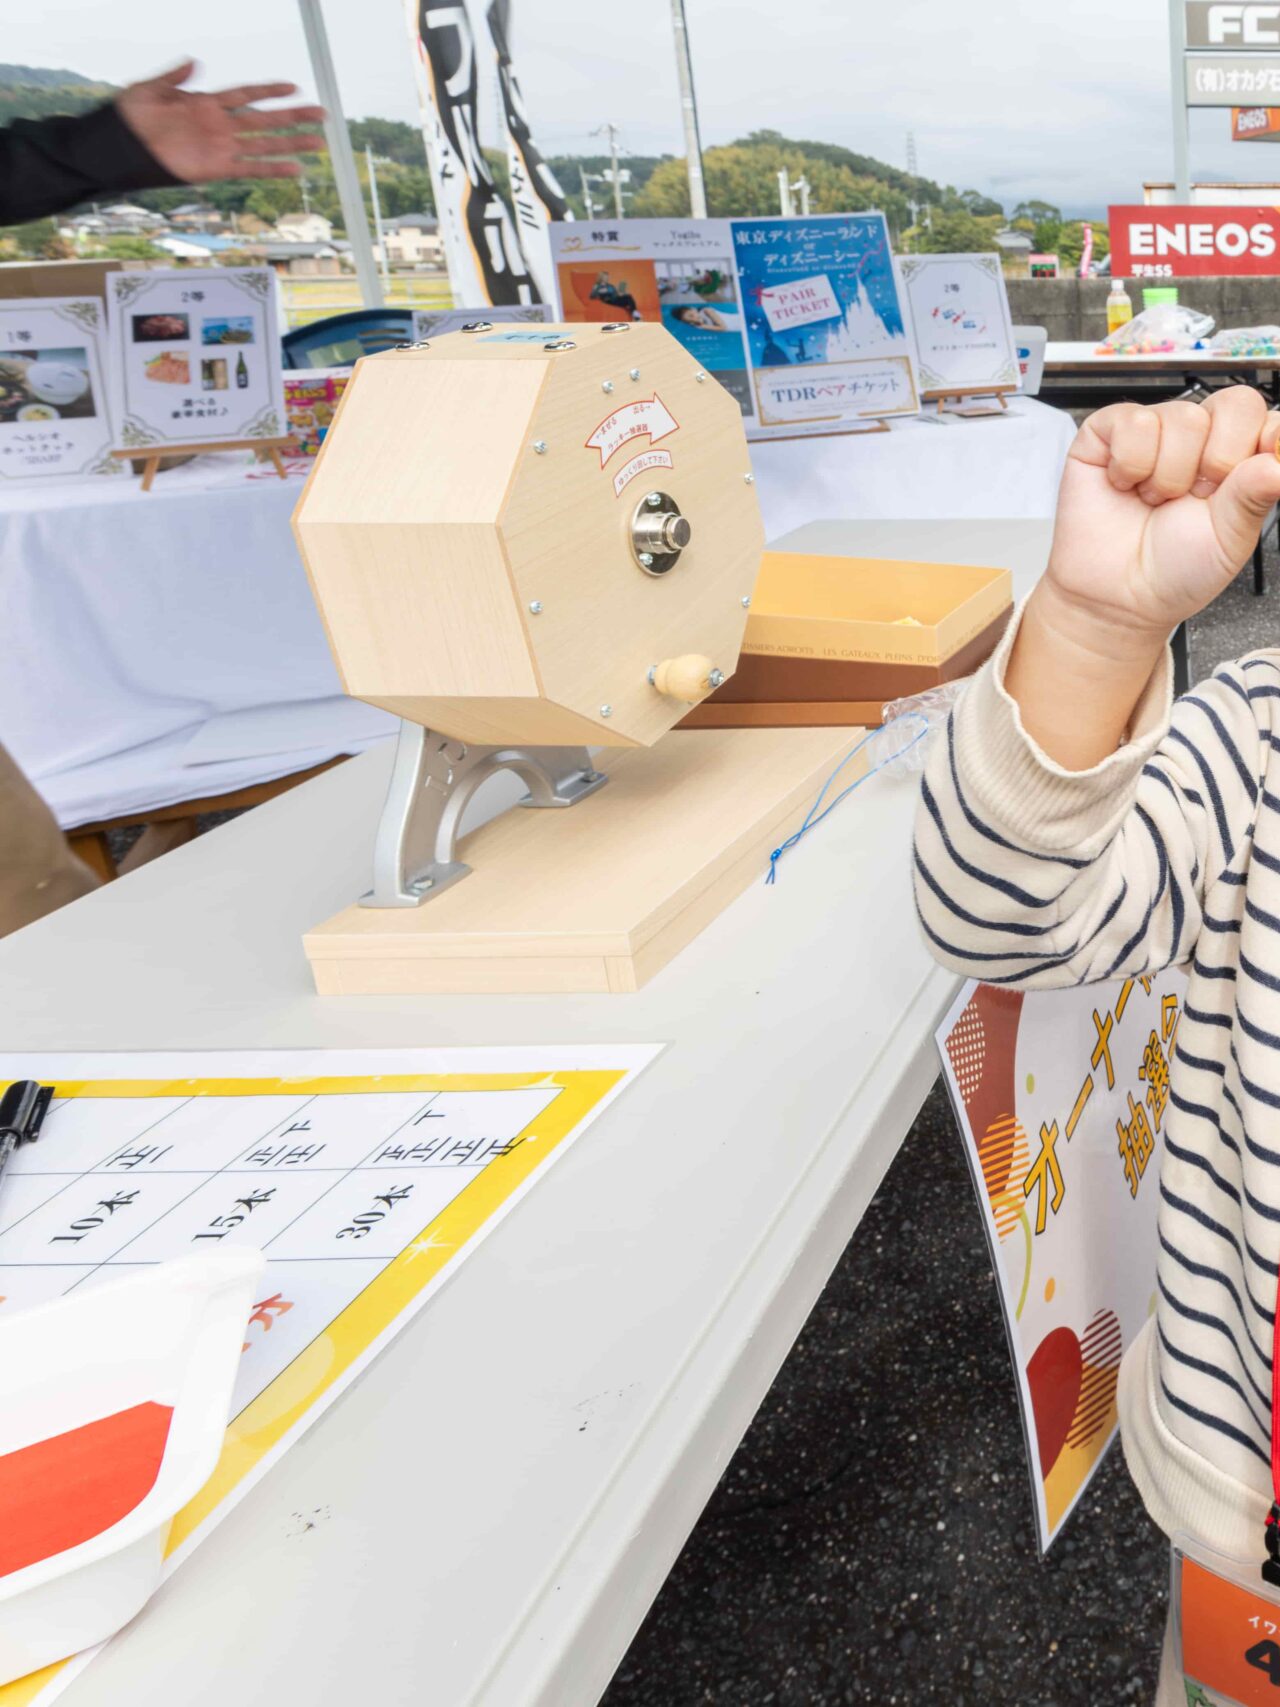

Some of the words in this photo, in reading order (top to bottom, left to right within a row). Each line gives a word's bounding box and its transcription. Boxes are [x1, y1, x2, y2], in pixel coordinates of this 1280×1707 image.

[1237, 109, 1267, 132] ENEOS
[591, 231, 620, 243] 特賞
[736, 225, 878, 245] 東京ディズニーランド
[1128, 222, 1276, 257] ENEOS
[764, 250, 861, 267] ディズニーシー
[181, 291, 205, 304] 2等
[778, 287, 816, 305] PAIR
[772, 297, 832, 321] TICKET
[771, 379, 901, 403] TDRペアチケット
[823, 647, 837, 656] LES
[885, 652, 913, 662] PLEINS
[1022, 972, 1157, 1236] オーナー
[48, 1189, 141, 1244] 10本
[191, 1187, 278, 1242] 15本
[335, 1183, 415, 1240] 30本
